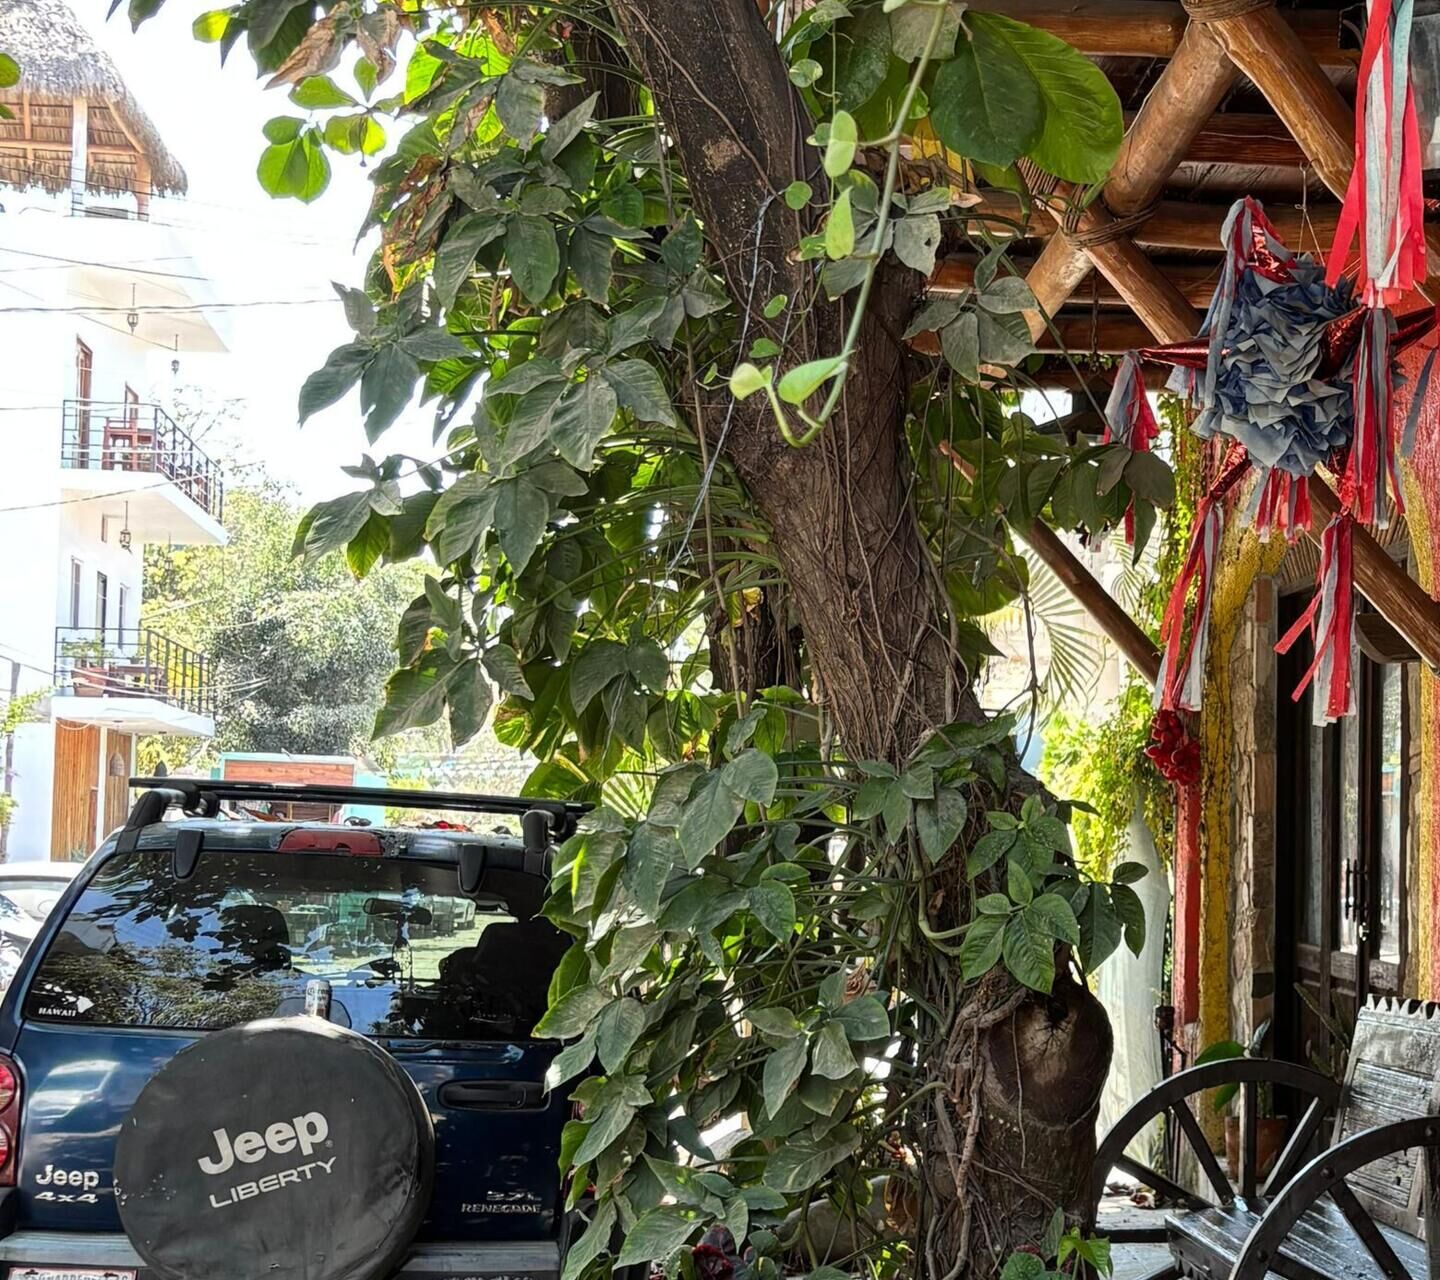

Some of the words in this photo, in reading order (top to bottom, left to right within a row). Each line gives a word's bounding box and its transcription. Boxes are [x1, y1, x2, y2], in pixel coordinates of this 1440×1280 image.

[38, 1007, 77, 1017] HAWAII
[198, 1111, 329, 1175] Jeep
[35, 1164, 99, 1191] Jeep
[209, 1156, 337, 1208] LIBERTY
[461, 1203, 542, 1213] RENEGADE
